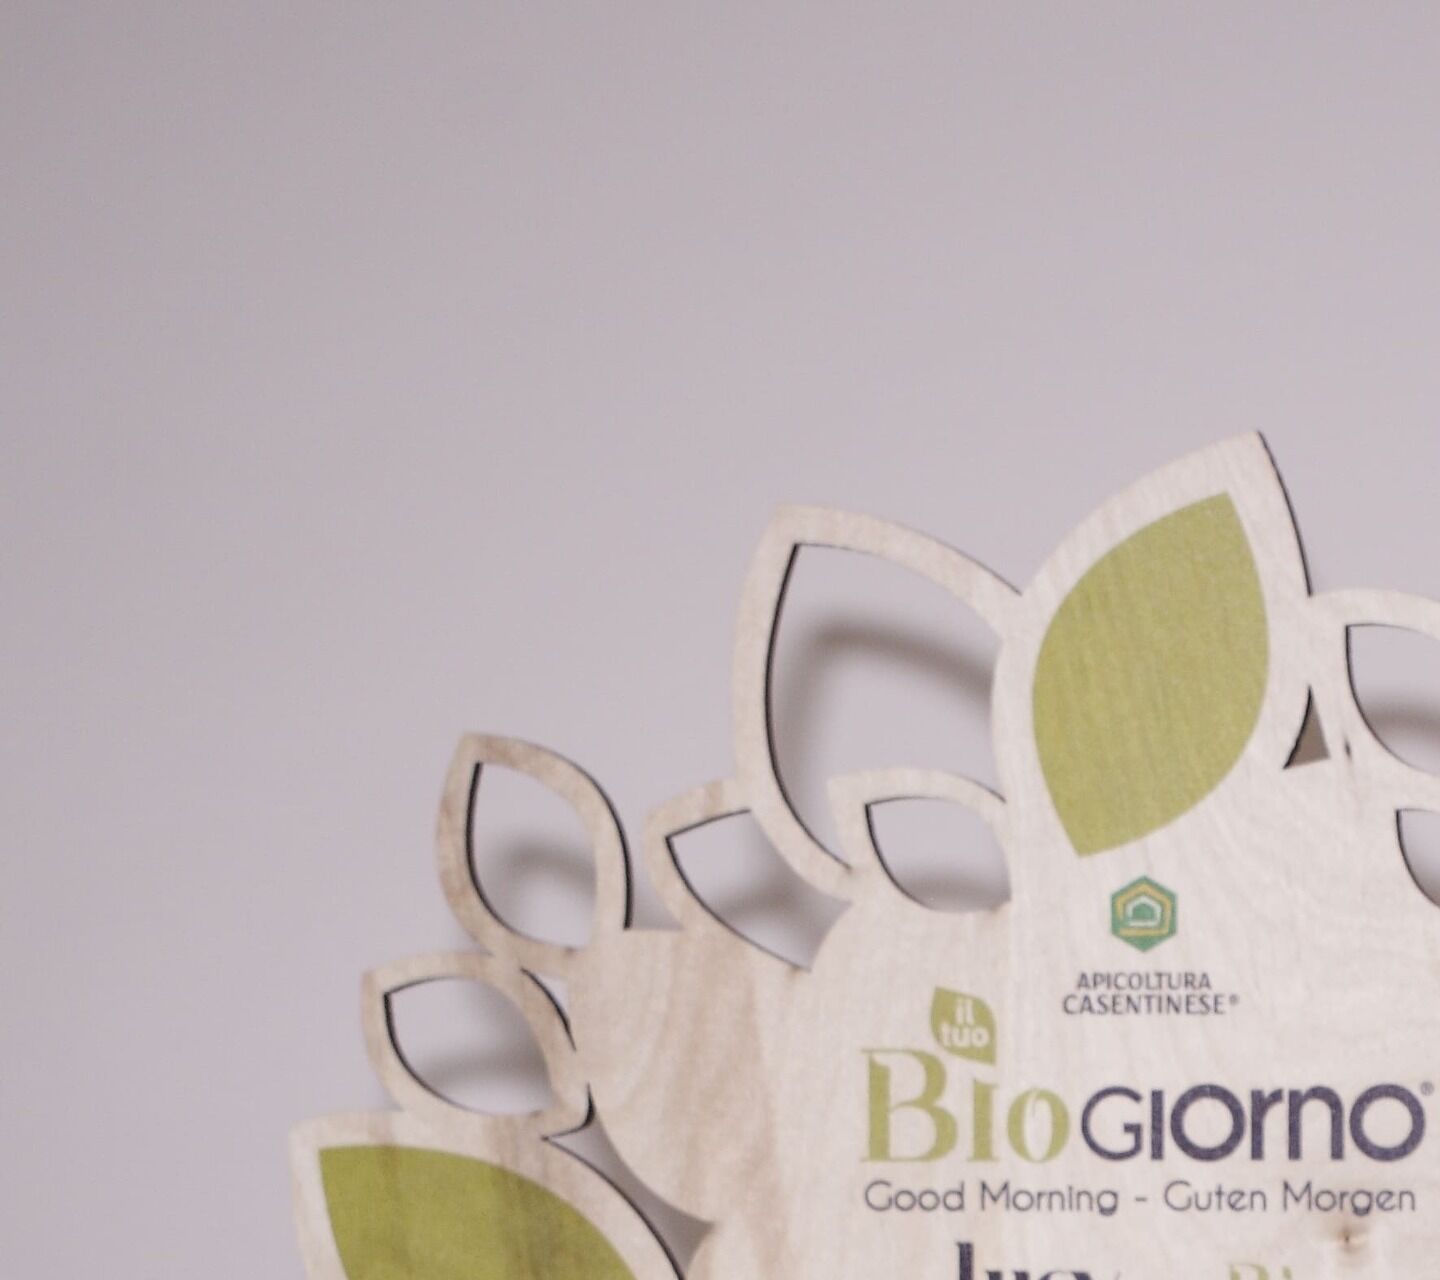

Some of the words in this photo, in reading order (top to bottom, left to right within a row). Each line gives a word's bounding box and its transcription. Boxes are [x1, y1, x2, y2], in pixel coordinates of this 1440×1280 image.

[1077, 972, 1212, 991] APICOLTURA
[956, 998, 974, 1025] il
[1062, 994, 1226, 1015] CASENTINESE
[940, 1021, 990, 1048] tuo
[864, 1180, 965, 1212] Good
[980, 1180, 1119, 1216] Morning
[1164, 1180, 1267, 1212] Guten
[1282, 1180, 1417, 1216] Morgen
